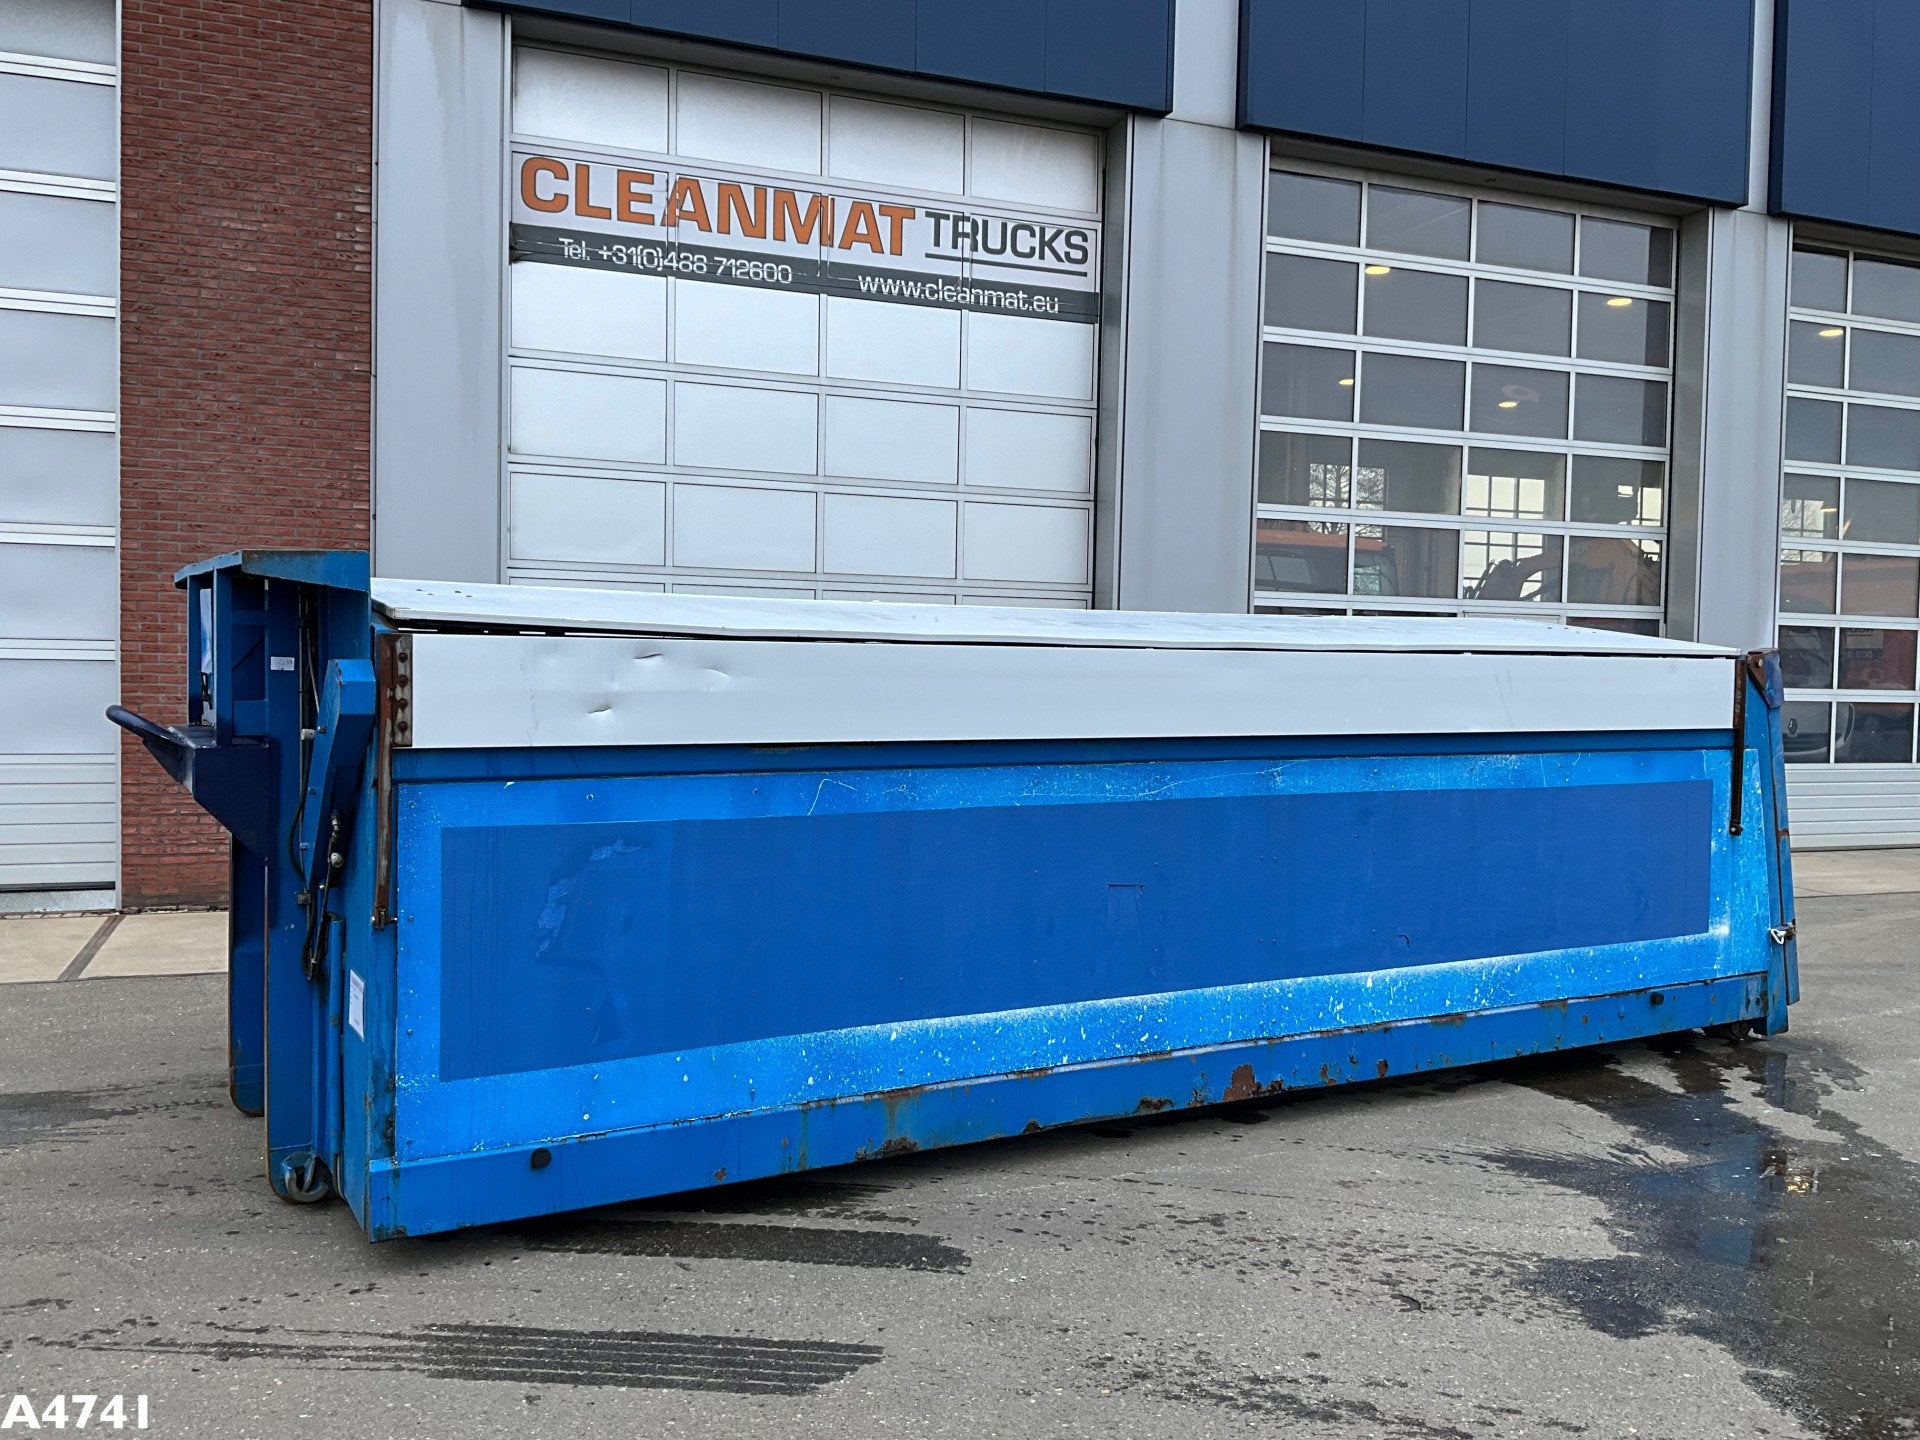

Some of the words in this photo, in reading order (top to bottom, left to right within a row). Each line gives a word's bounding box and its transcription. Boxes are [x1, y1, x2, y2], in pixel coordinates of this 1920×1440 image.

[520, 156, 916, 257] CLEANMAT
[924, 210, 1089, 265] TRUCKS
[558, 238, 591, 262] Tel.
[713, 256, 793, 284] 712600
[857, 275, 1059, 314] www.cleanmat.eu
